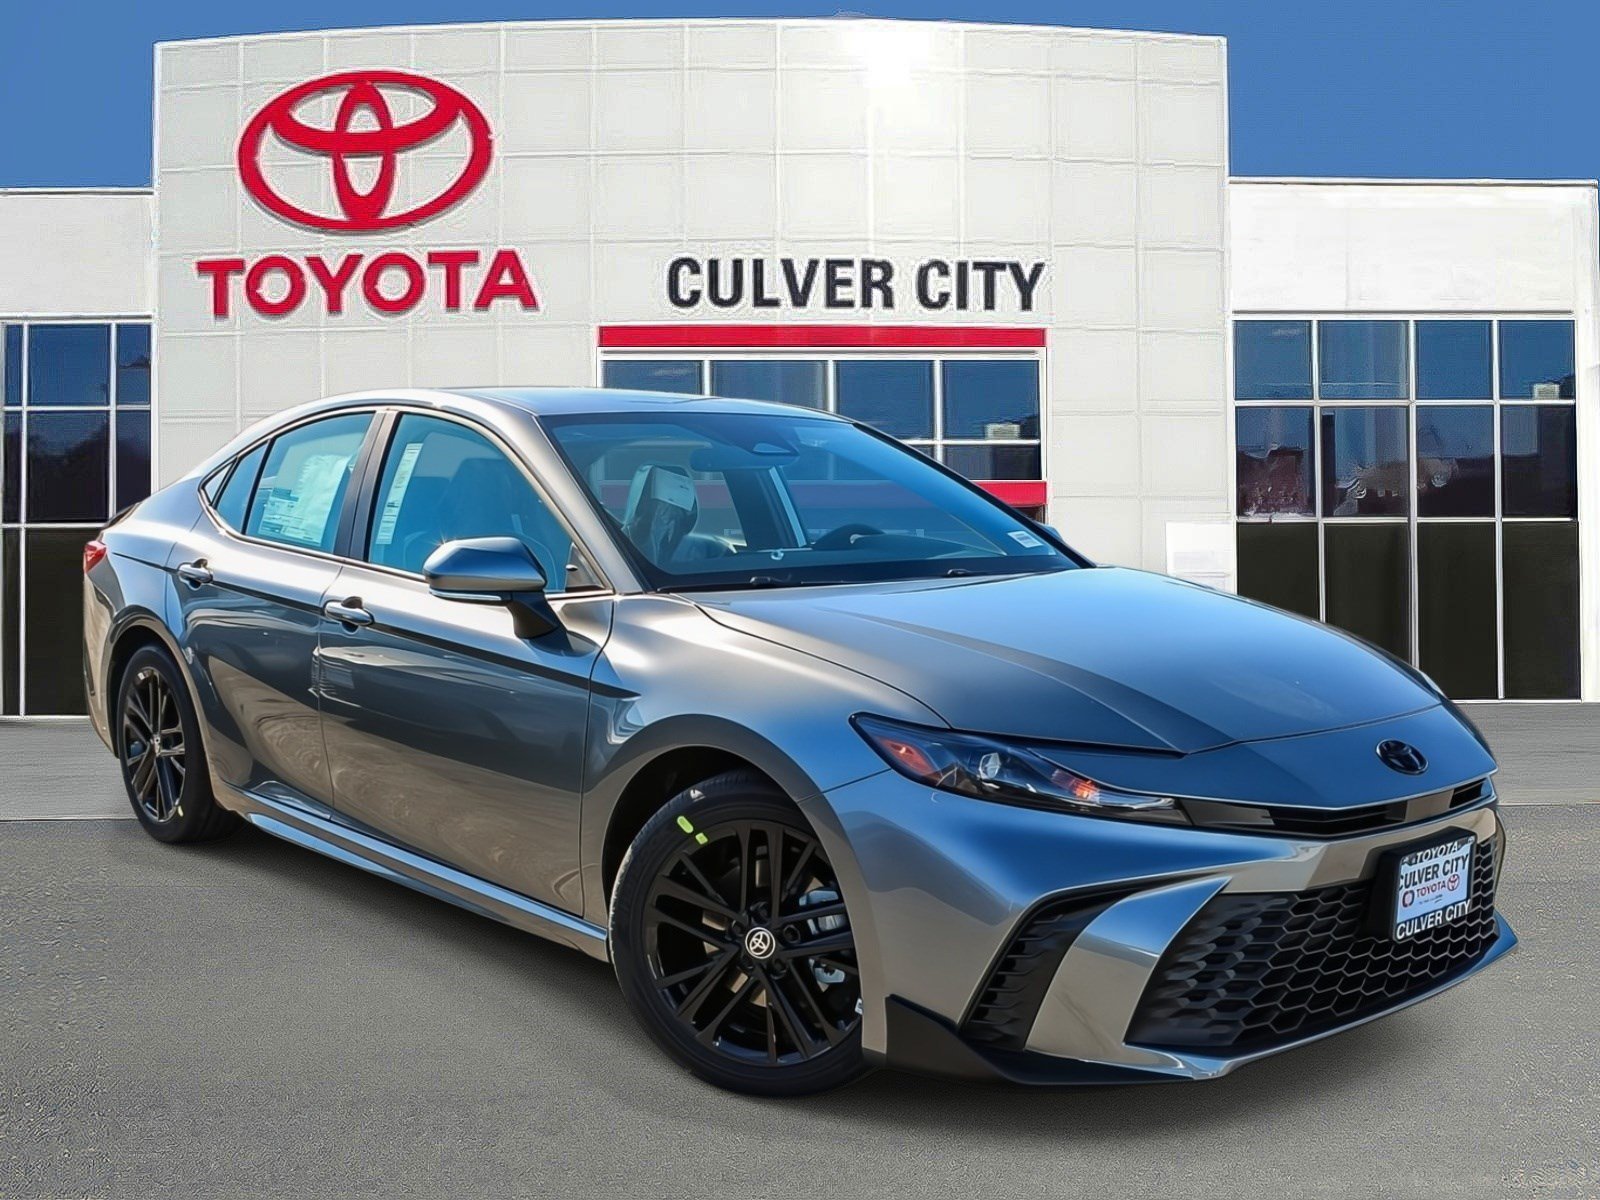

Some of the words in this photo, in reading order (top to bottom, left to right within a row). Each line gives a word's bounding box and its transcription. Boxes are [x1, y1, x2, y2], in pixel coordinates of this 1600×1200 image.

[196, 250, 539, 319] TOYOTA
[667, 258, 894, 308] CULVER
[915, 260, 1045, 310] CITY
[1416, 841, 1458, 863] TOYOTA
[1442, 854, 1469, 876] CITY
[1416, 880, 1446, 898] TOYOTA
[1396, 910, 1442, 940] CULVER
[1445, 899, 1471, 921] CITY
